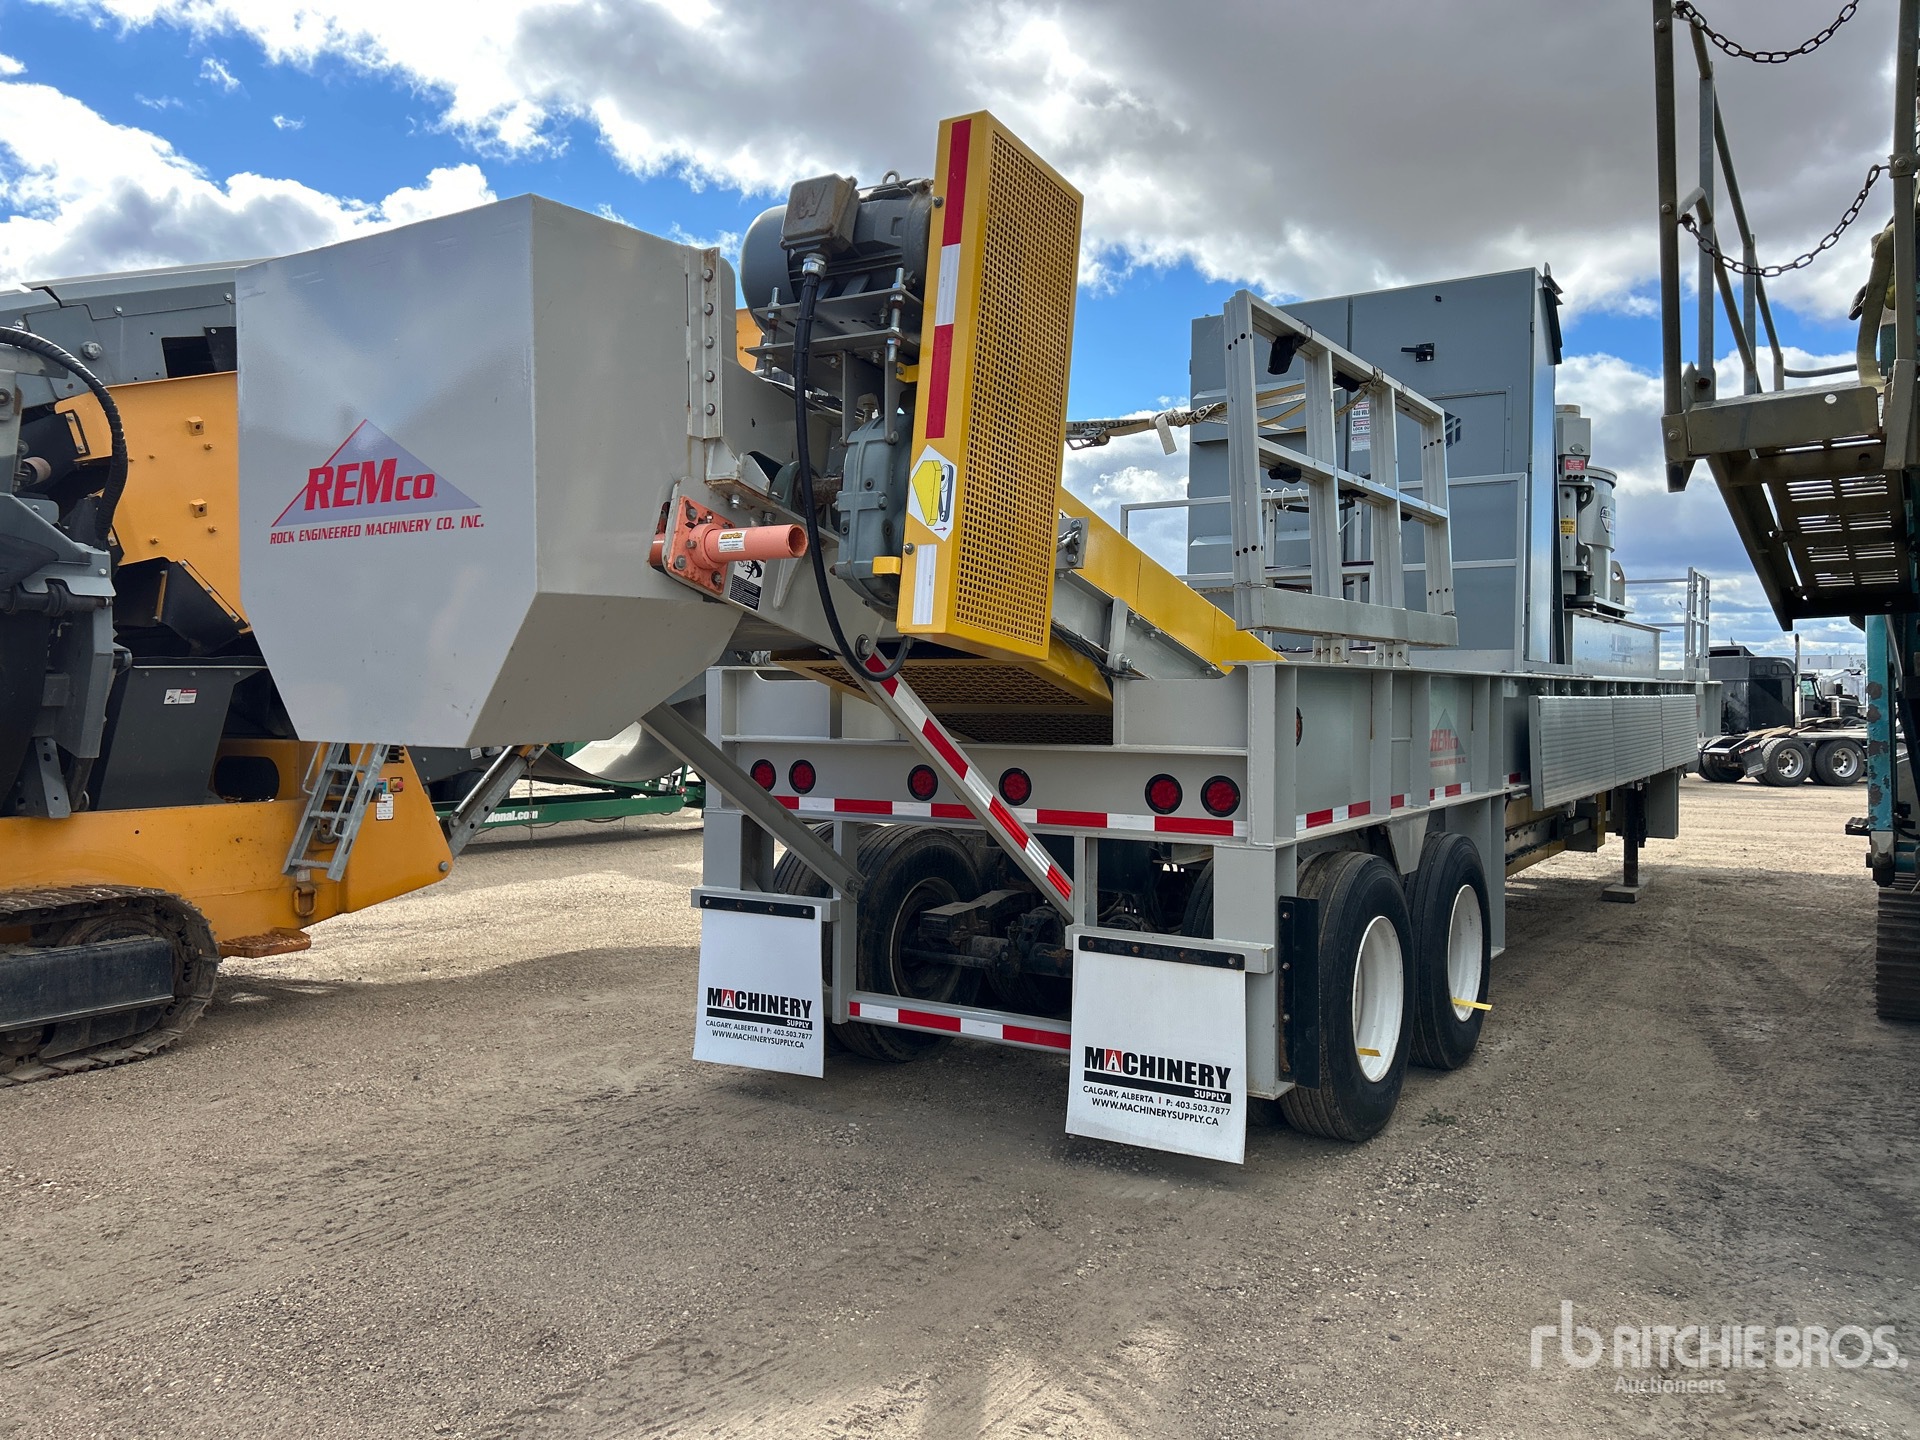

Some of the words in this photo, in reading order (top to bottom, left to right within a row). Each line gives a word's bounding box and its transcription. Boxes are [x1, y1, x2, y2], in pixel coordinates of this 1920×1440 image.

[270, 530, 295, 544] ROCK
[299, 524, 361, 542] ENGINEERED
[365, 518, 432, 536] MACHINERY
[436, 516, 455, 530] CO.
[460, 514, 484, 528] INC.
[707, 987, 812, 1019] MACHINERY
[705, 1020, 733, 1030] CALGARY,
[734, 1023, 758, 1032] ALBERTA
[773, 1029, 813, 1040] 403.503.7877
[786, 1019, 810, 1029] SUPPLY
[712, 1030, 805, 1049] WWW.MACHINERYSUPPLY.CA
[1084, 1046, 1231, 1089] MACHINERY
[1082, 1085, 1119, 1098] CALGARY,
[1120, 1091, 1154, 1103] ALBERTA
[1175, 1100, 1231, 1116] 403.503.7877
[1193, 1089, 1227, 1102] SUPPLY
[1091, 1097, 1219, 1126] WWW.MACHINERYSUPPLY.CA
